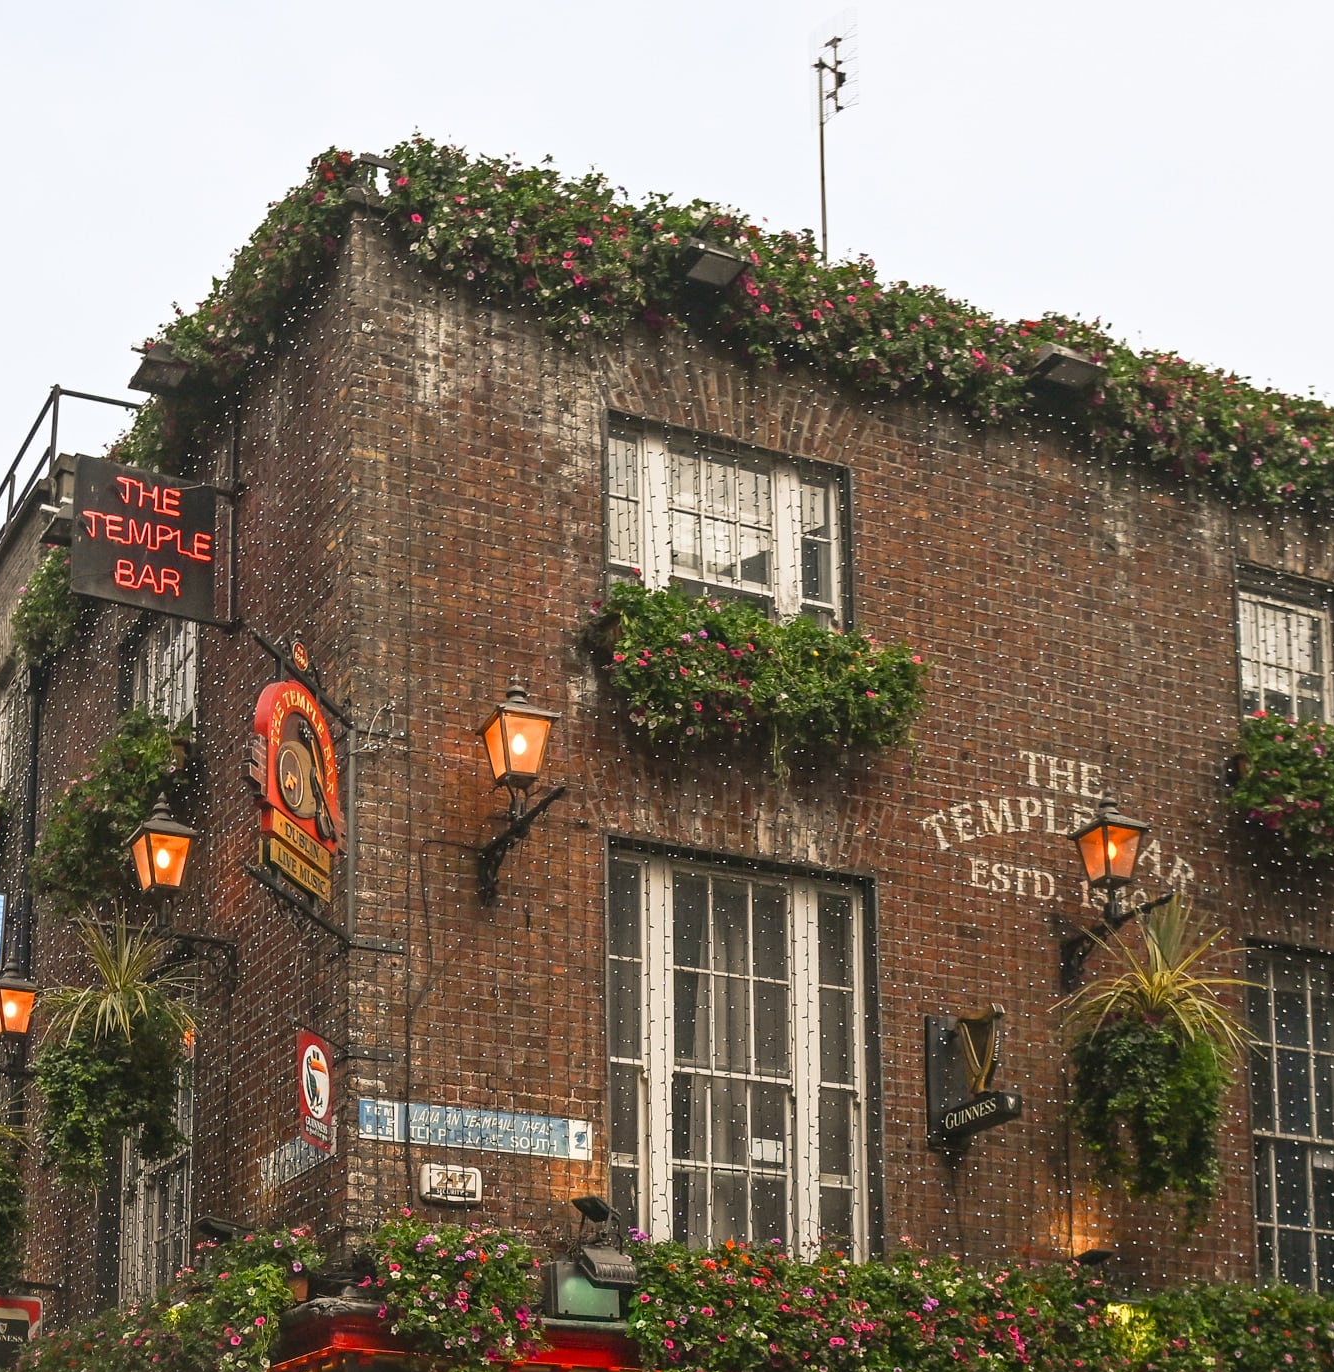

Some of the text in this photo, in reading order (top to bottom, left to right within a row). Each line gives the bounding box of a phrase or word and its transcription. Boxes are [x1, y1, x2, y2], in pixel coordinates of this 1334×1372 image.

[270, 690, 335, 795] THE TEMPLE BAR
[1019, 750, 1104, 800] THE
[284, 822, 318, 858] DUBLIN
[922, 796, 1195, 896] TEMPLE AR
[277, 846, 326, 895] LIVE MUSIC
[968, 857, 1063, 902] ESTD.
[304, 1115, 328, 1135] GUINNESS
[444, 1111, 461, 1125] AN
[945, 1097, 996, 1130] GUINNESS
[510, 1135, 557, 1152] SOUTH
